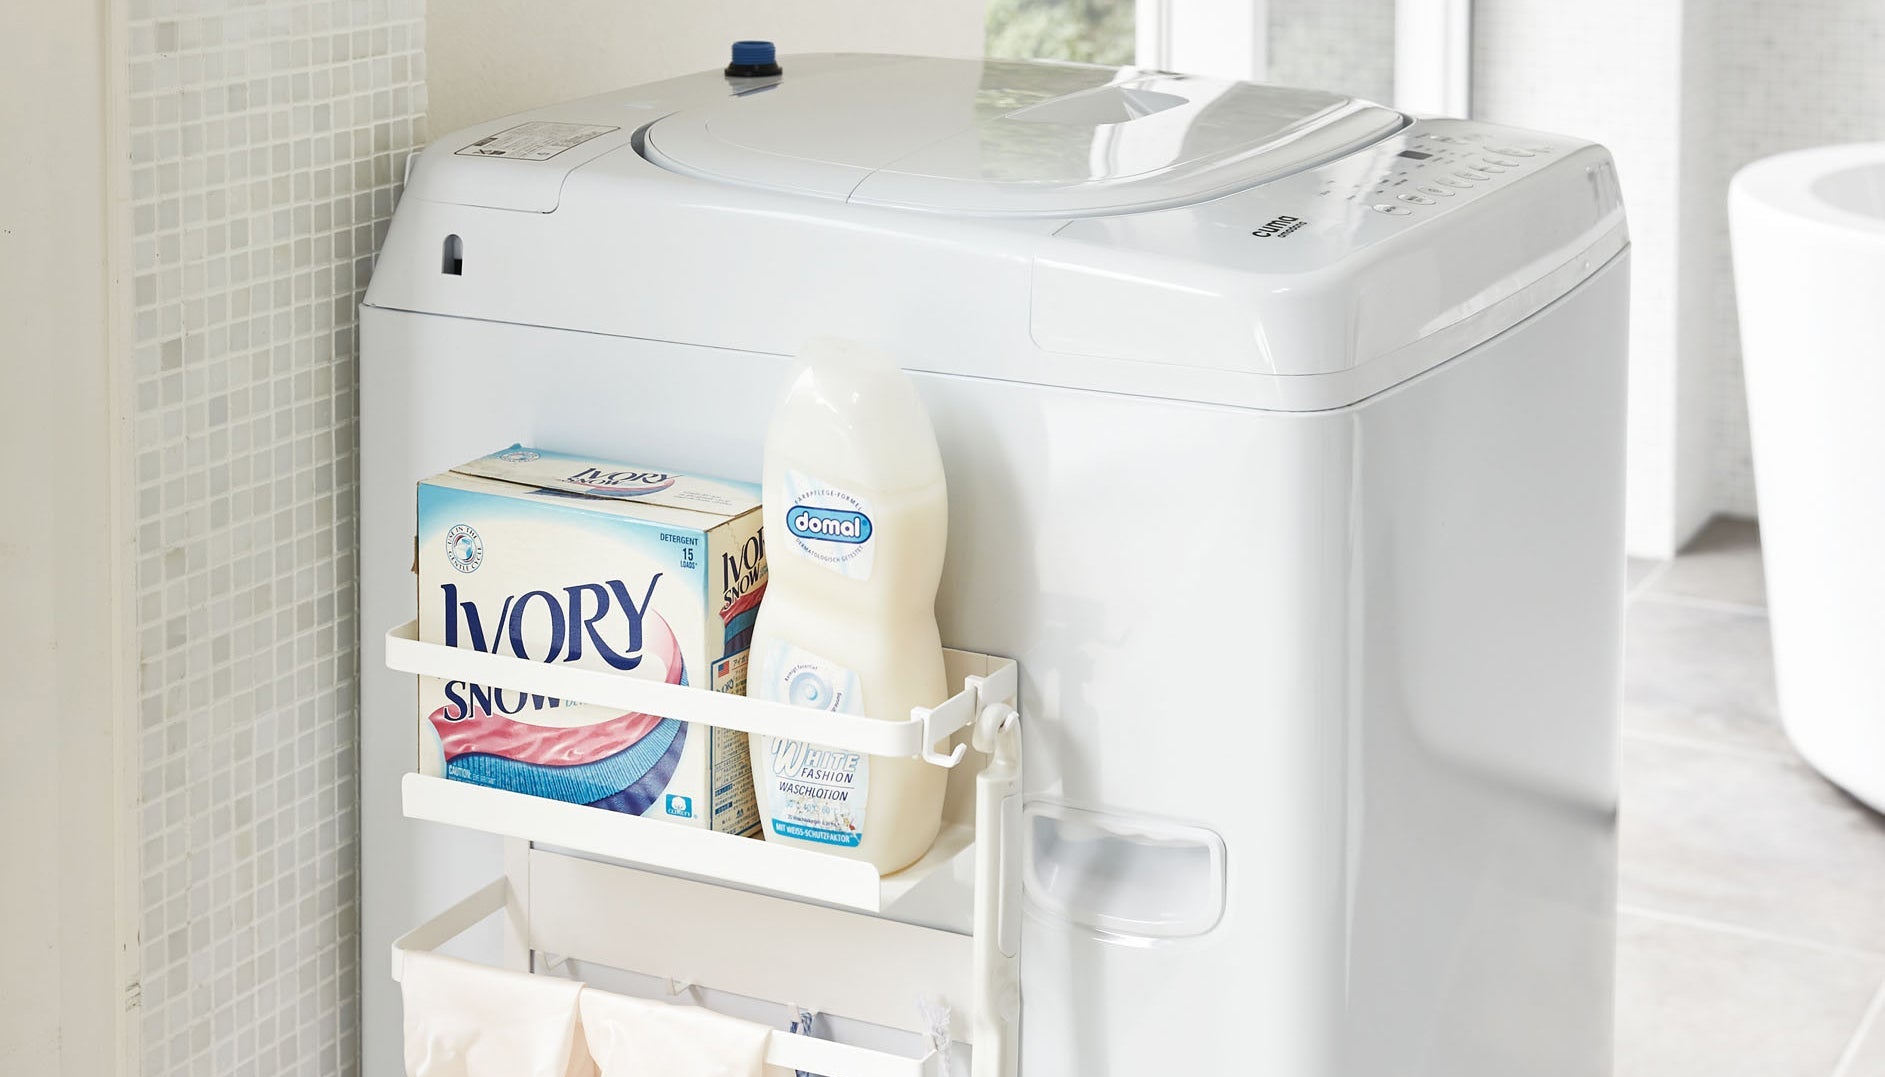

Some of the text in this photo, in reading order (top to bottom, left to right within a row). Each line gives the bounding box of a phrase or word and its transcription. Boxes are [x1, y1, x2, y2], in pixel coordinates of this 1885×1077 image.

[1252, 215, 1299, 237] cuma
[572, 467, 684, 484] IVORY
[794, 510, 861, 539] domal
[660, 533, 699, 546] DETERGENT
[682, 547, 694, 561] 15
[723, 561, 760, 611] SNOW
[440, 572, 664, 671] IVORY
[771, 737, 861, 778] WHITE
[800, 767, 854, 784] FASHION
[779, 781, 849, 801] WASCHLOTION
[775, 822, 786, 832] MIT
